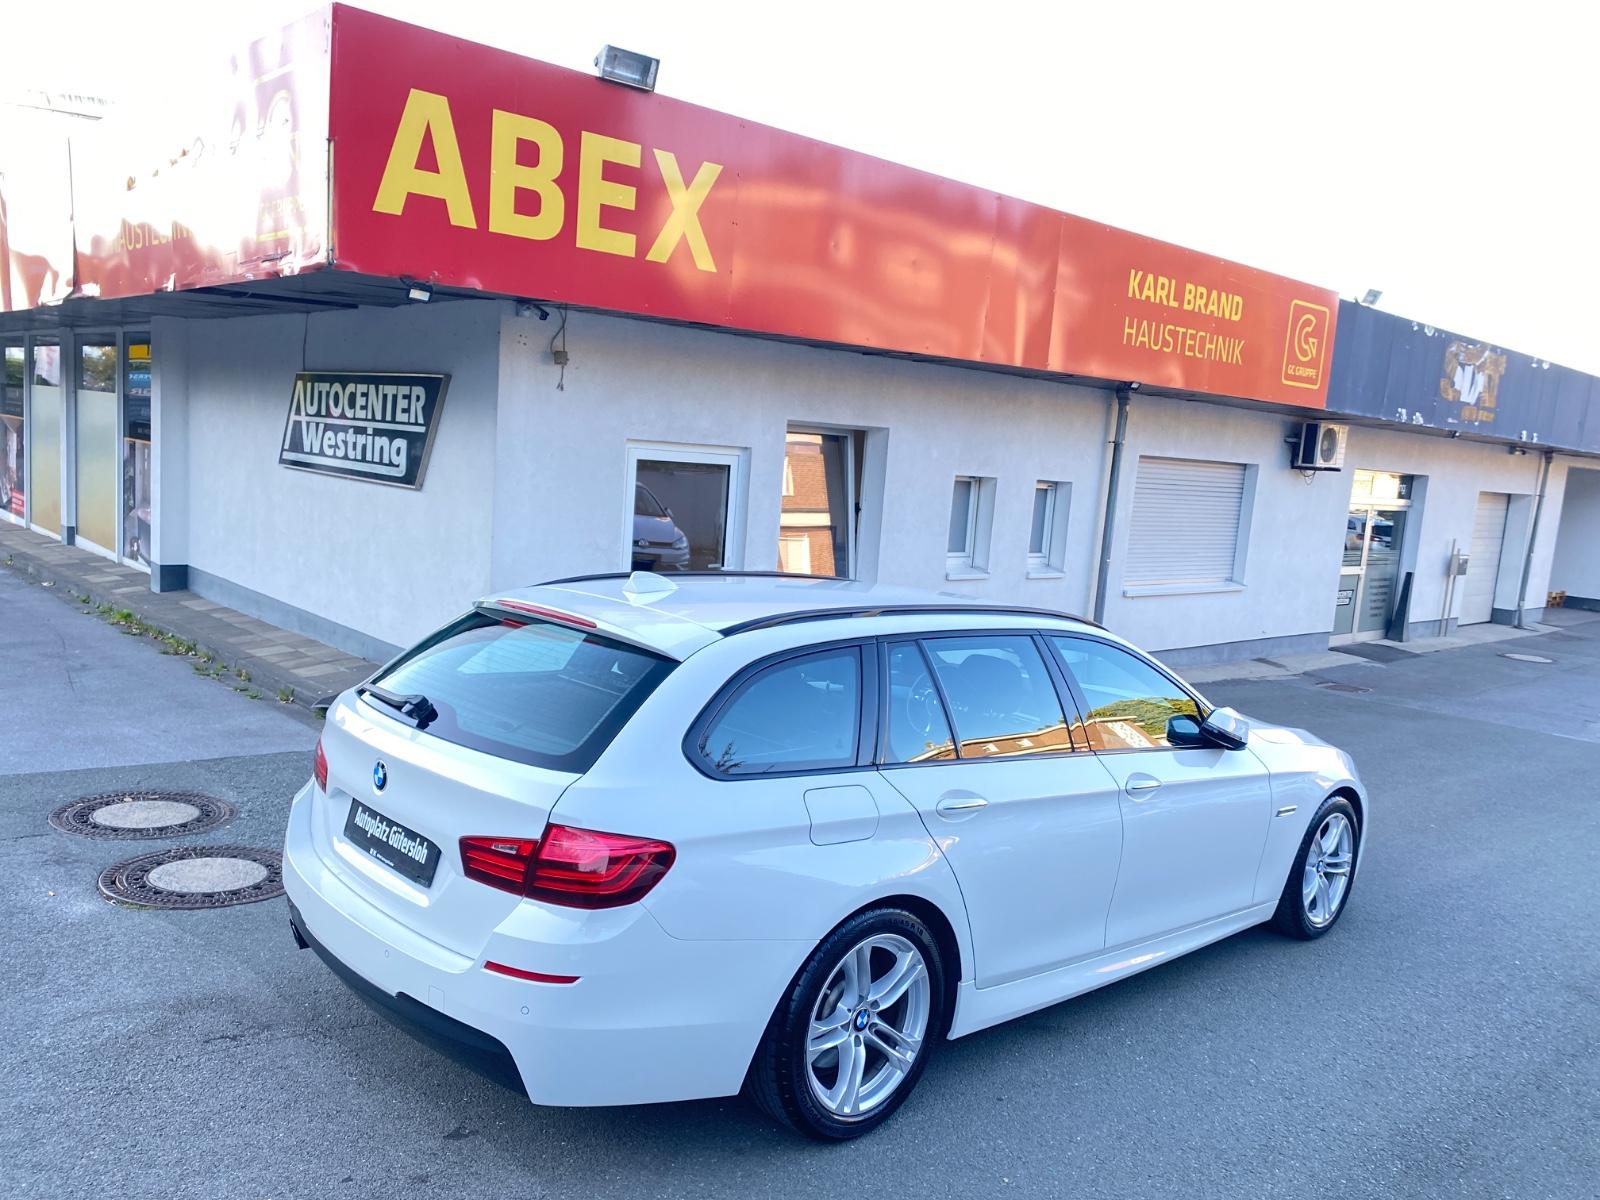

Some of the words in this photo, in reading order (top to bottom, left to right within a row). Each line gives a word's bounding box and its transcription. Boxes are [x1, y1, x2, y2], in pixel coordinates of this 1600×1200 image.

[372, 88, 724, 273] ABEX
[1128, 269, 1179, 308] KARL
[1183, 283, 1243, 321] BRAND
[1123, 316, 1245, 365] HAUSTECHNIK
[284, 380, 426, 449] AUTOCENTER
[303, 422, 408, 477] Westring
[354, 806, 390, 842] Autoplatz
[388, 826, 428, 865] Gütersloh
